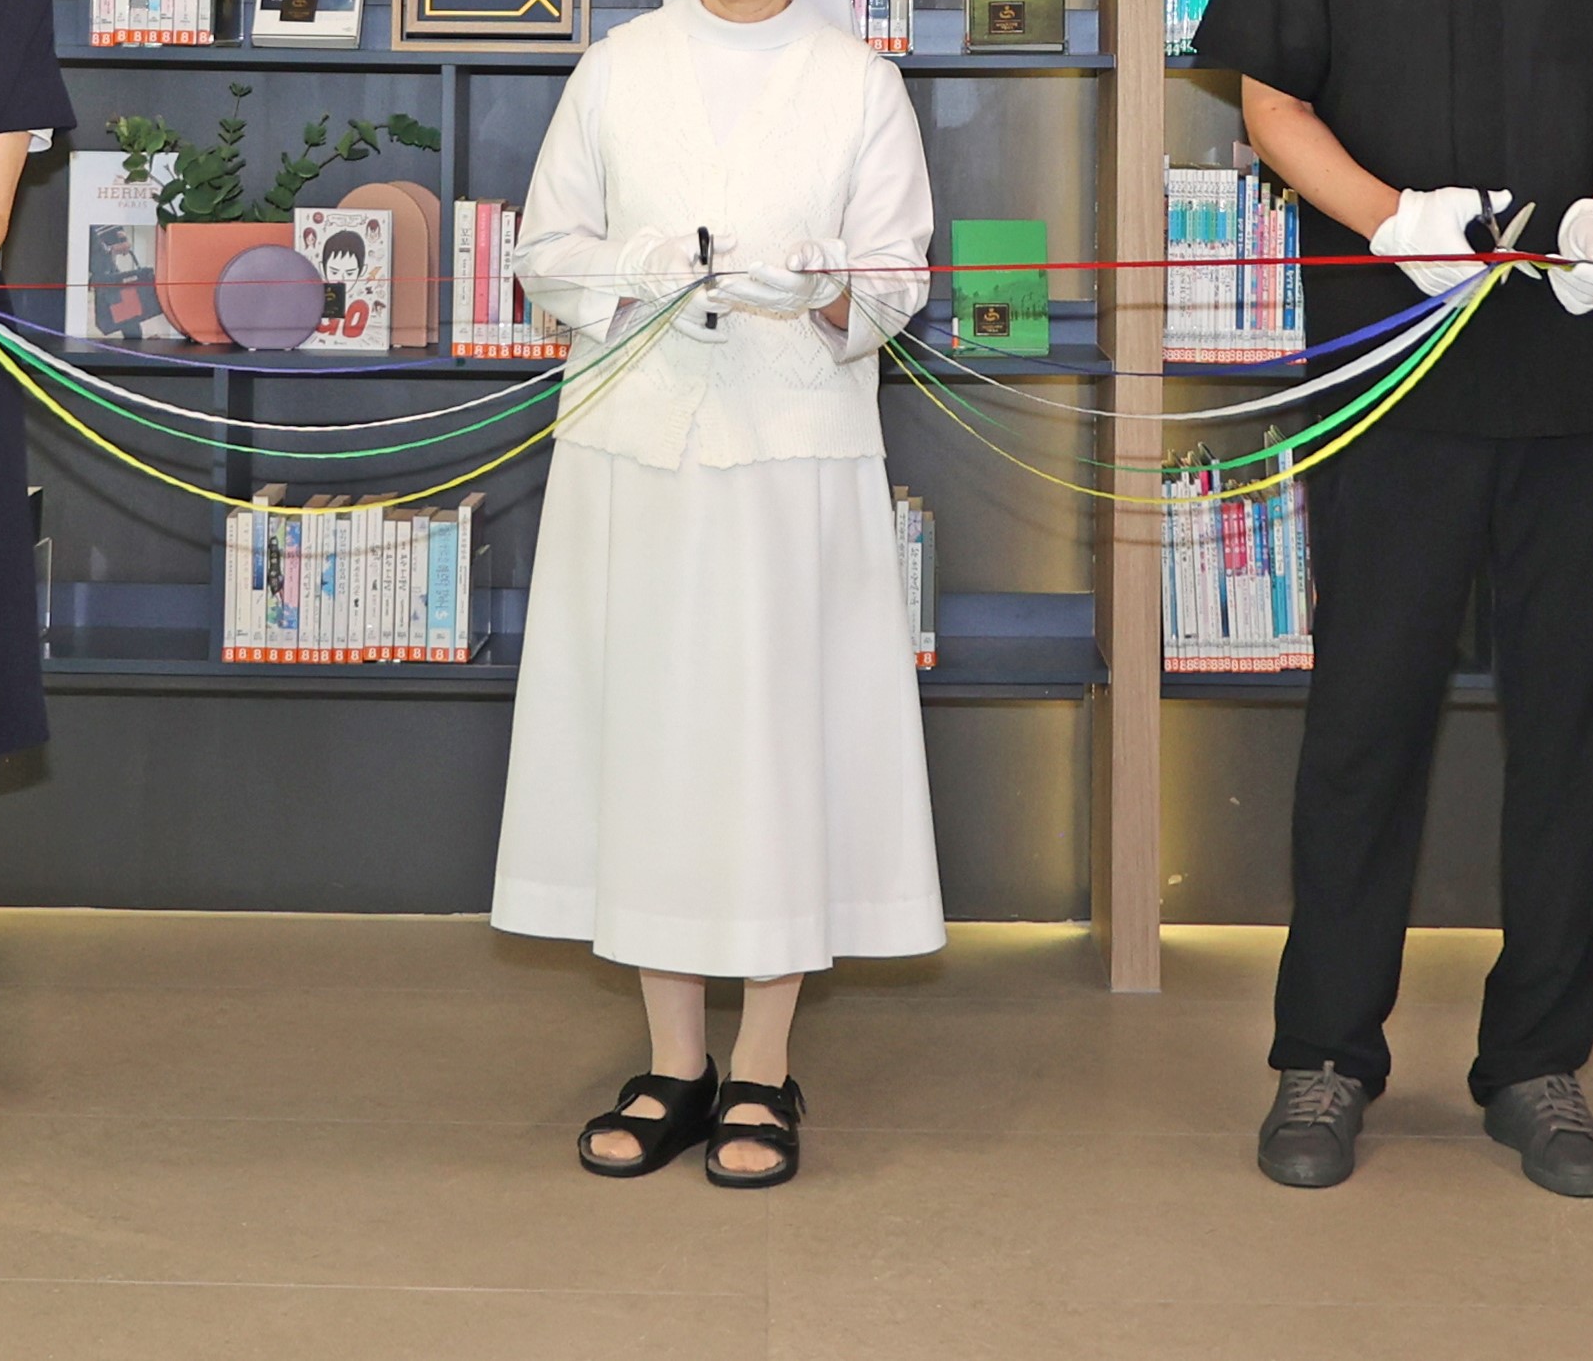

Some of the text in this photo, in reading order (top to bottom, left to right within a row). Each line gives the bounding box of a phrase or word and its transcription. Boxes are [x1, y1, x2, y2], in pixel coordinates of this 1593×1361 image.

[116, 29, 127, 42] 8
[149, 30, 157, 43] 8
[893, 37, 902, 50] 8
[97, 186, 160, 200] HERME
[238, 647, 247, 660] 8
[381, 646, 390, 659] 8
